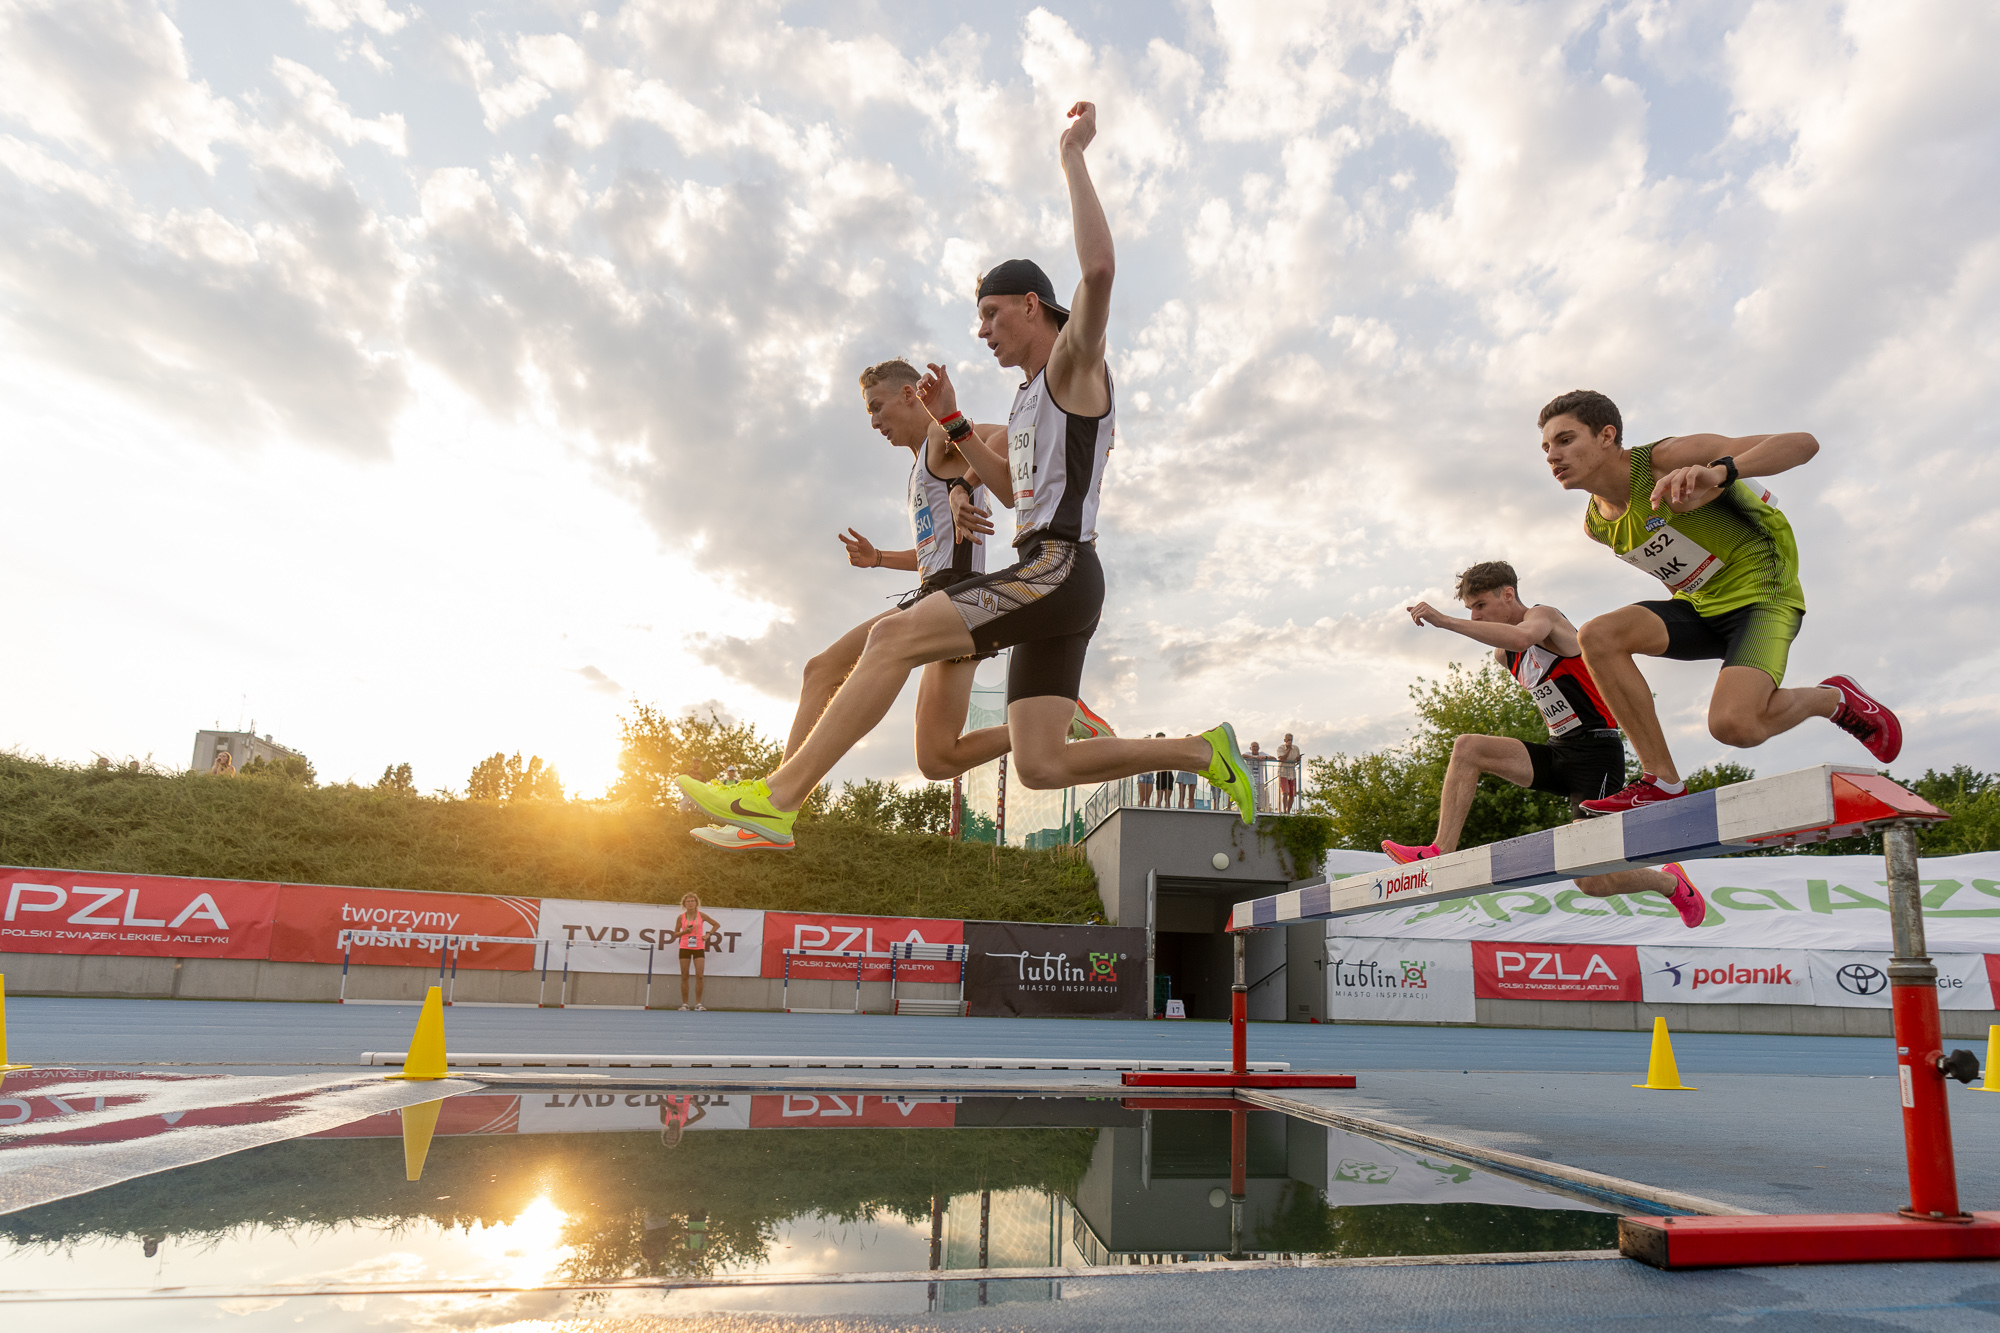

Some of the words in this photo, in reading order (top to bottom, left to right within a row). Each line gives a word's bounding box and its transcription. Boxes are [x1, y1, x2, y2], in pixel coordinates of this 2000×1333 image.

[1014, 433, 1029, 450] 250
[916, 514, 932, 534] SKI
[1643, 533, 1674, 558] 452
[1686, 577, 1704, 592] 2023
[1533, 685, 1553, 701] 333
[1386, 868, 1429, 899] polanik
[4, 883, 229, 929] PZLA
[341, 903, 460, 931] tworzymy
[1, 929, 52, 938] POLSKI
[55, 931, 117, 941] ZWIĄZEK
[119, 933, 170, 942] LEKKIEJ
[173, 935, 229, 944] ATLETYKI
[562, 924, 629, 949] TVP
[639, 928, 742, 953] SPRT
[792, 960, 823, 968] POLSKI
[1496, 951, 1617, 980] PZLA
[1692, 963, 1792, 990] polanik
[1935, 974, 1963, 988] cie
[1019, 984, 1057, 992] MIASTO
[1062, 985, 1118, 993] INSPIRACJI
